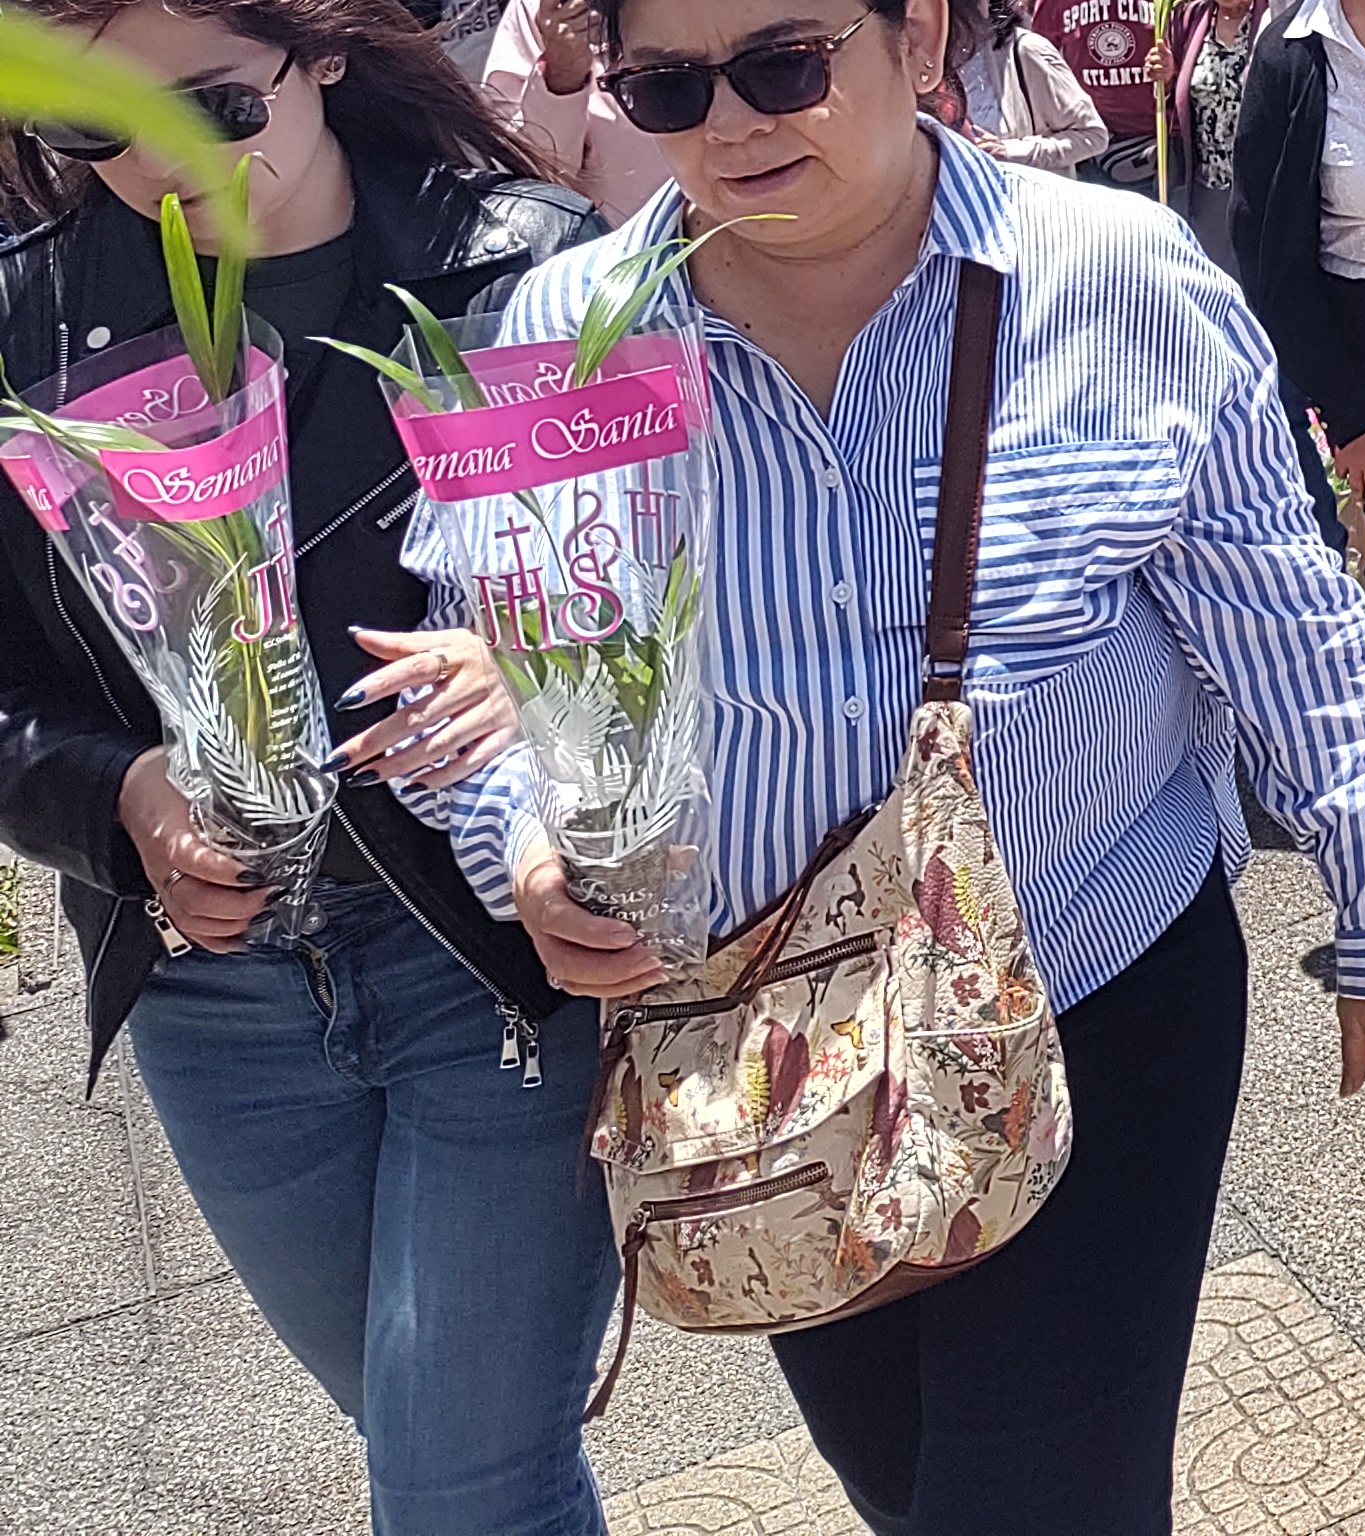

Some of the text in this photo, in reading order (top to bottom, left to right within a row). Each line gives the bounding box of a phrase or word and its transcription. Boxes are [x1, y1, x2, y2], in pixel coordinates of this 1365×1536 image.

[123, 435, 280, 504] Semana
[413, 402, 678, 481] emana Santa
